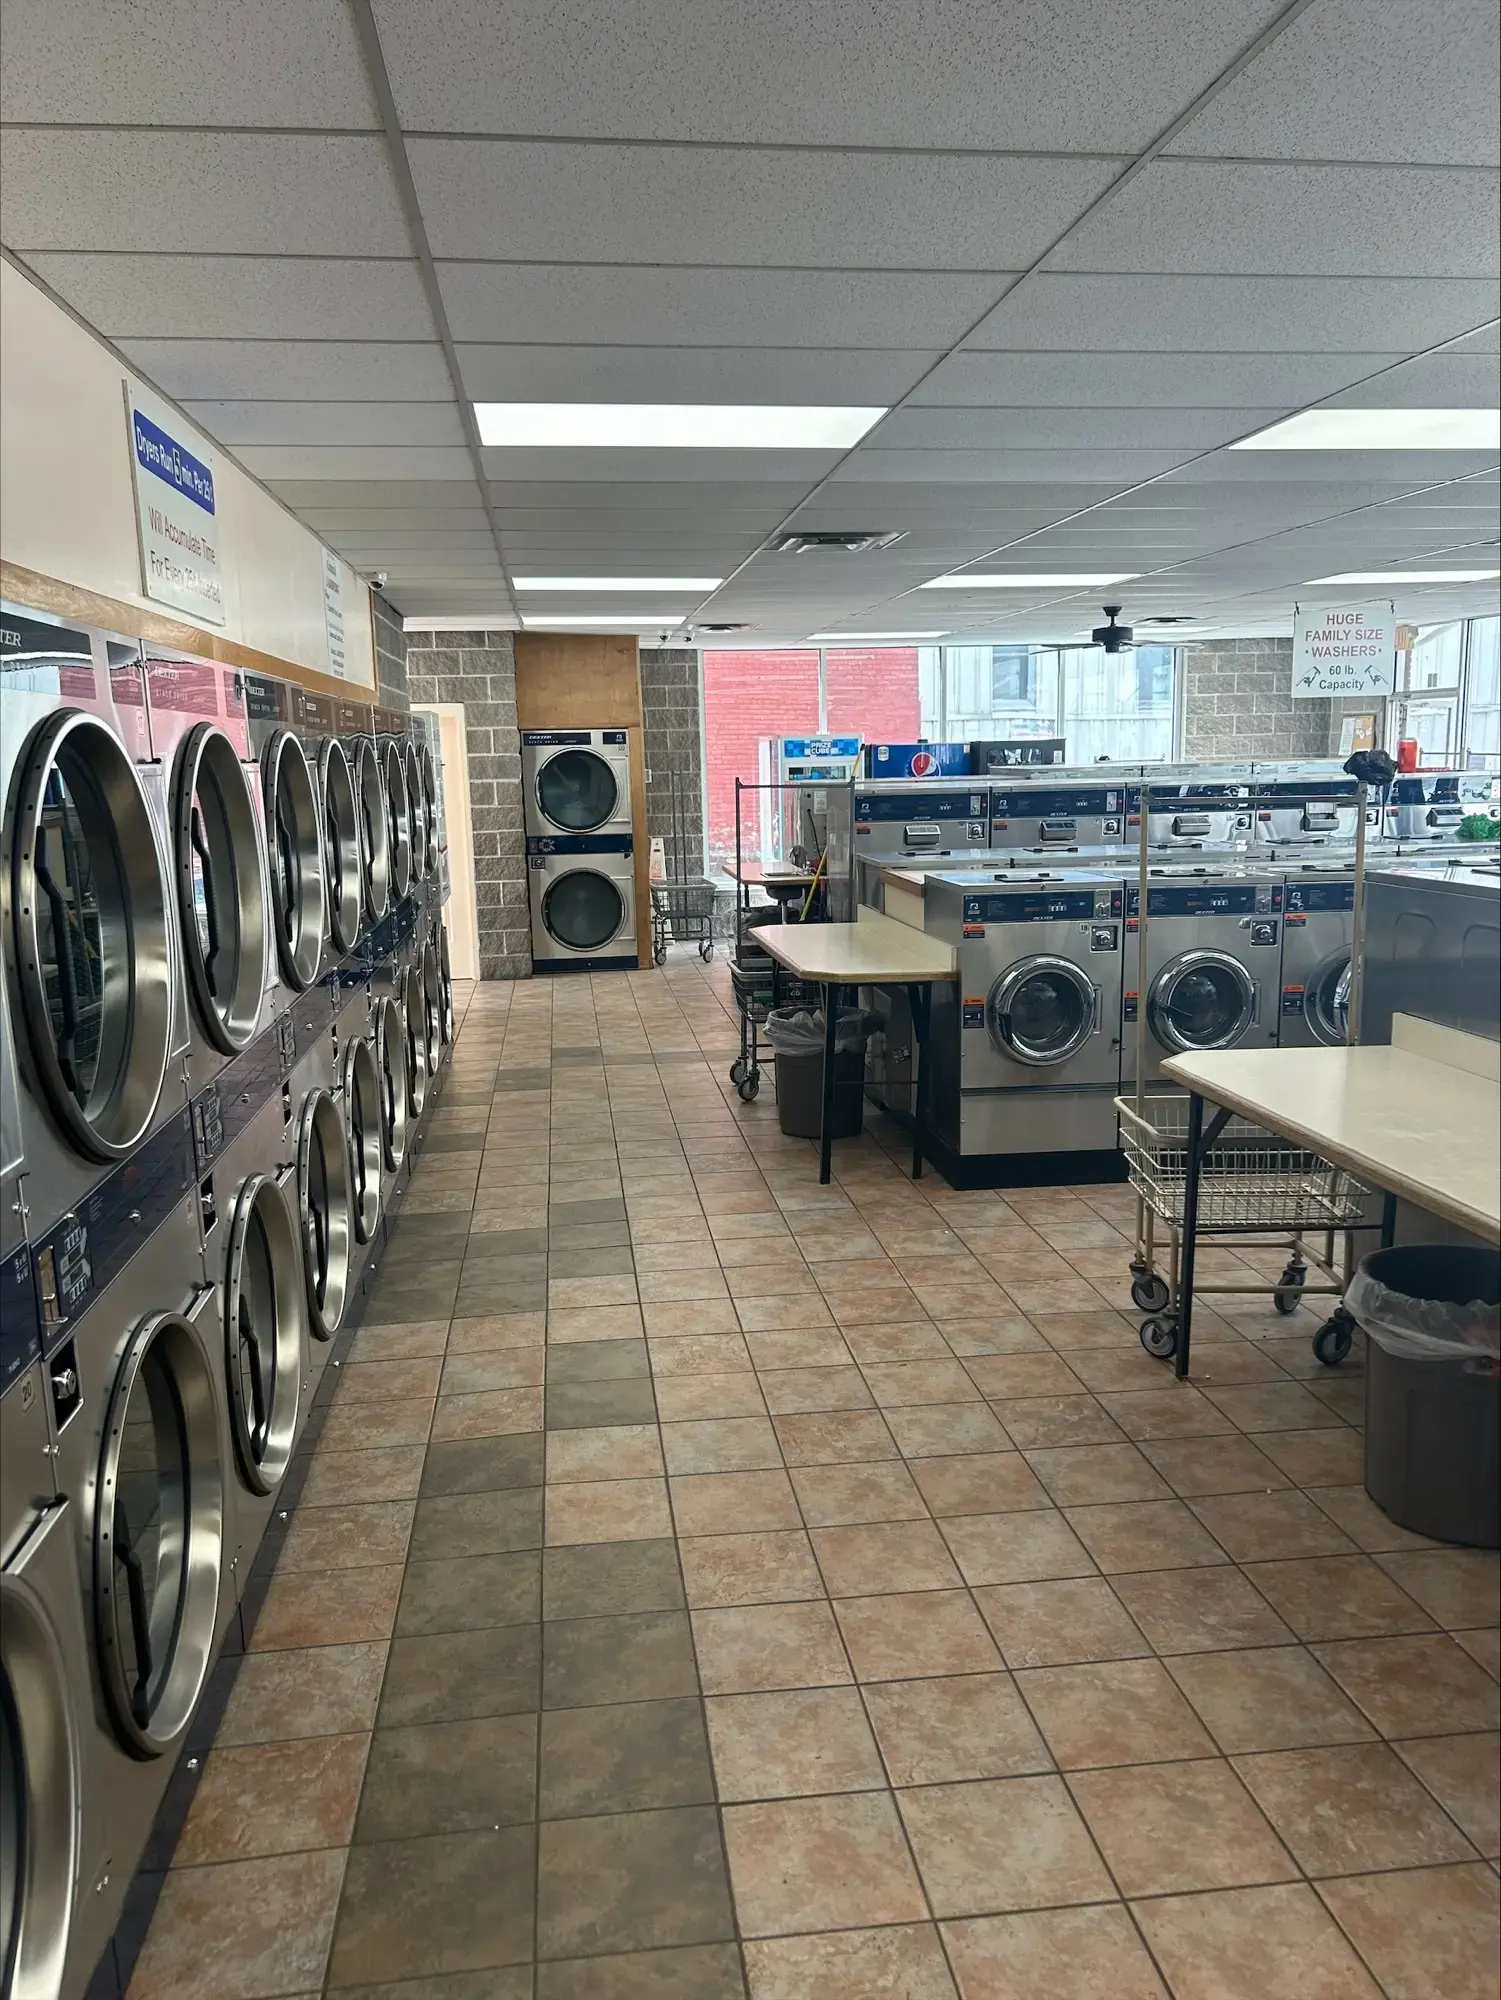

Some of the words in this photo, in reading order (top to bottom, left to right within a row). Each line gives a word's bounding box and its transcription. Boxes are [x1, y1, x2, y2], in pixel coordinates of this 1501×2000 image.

[136, 426, 160, 463] Dryers
[160, 444, 174, 474] Run
[194, 470, 204, 496] Per
[148, 505, 163, 535] Will
[164, 516, 202, 556] Accumulate
[201, 538, 216, 565] Time
[150, 550, 164, 577] For
[164, 557, 185, 585] Every
[1326, 613, 1364, 625] HUGE
[1305, 629, 1351, 642] FAMILY
[1355, 628, 1384, 640] SIZE
[1311, 645, 1377, 657] WASHERS
[1329, 665, 1341, 675] 60
[1344, 665, 1356, 675] lb.
[1319, 679, 1365, 691] Capacity
[811, 747, 832, 755] CUBE
[22, 1381, 32, 1402] 20
